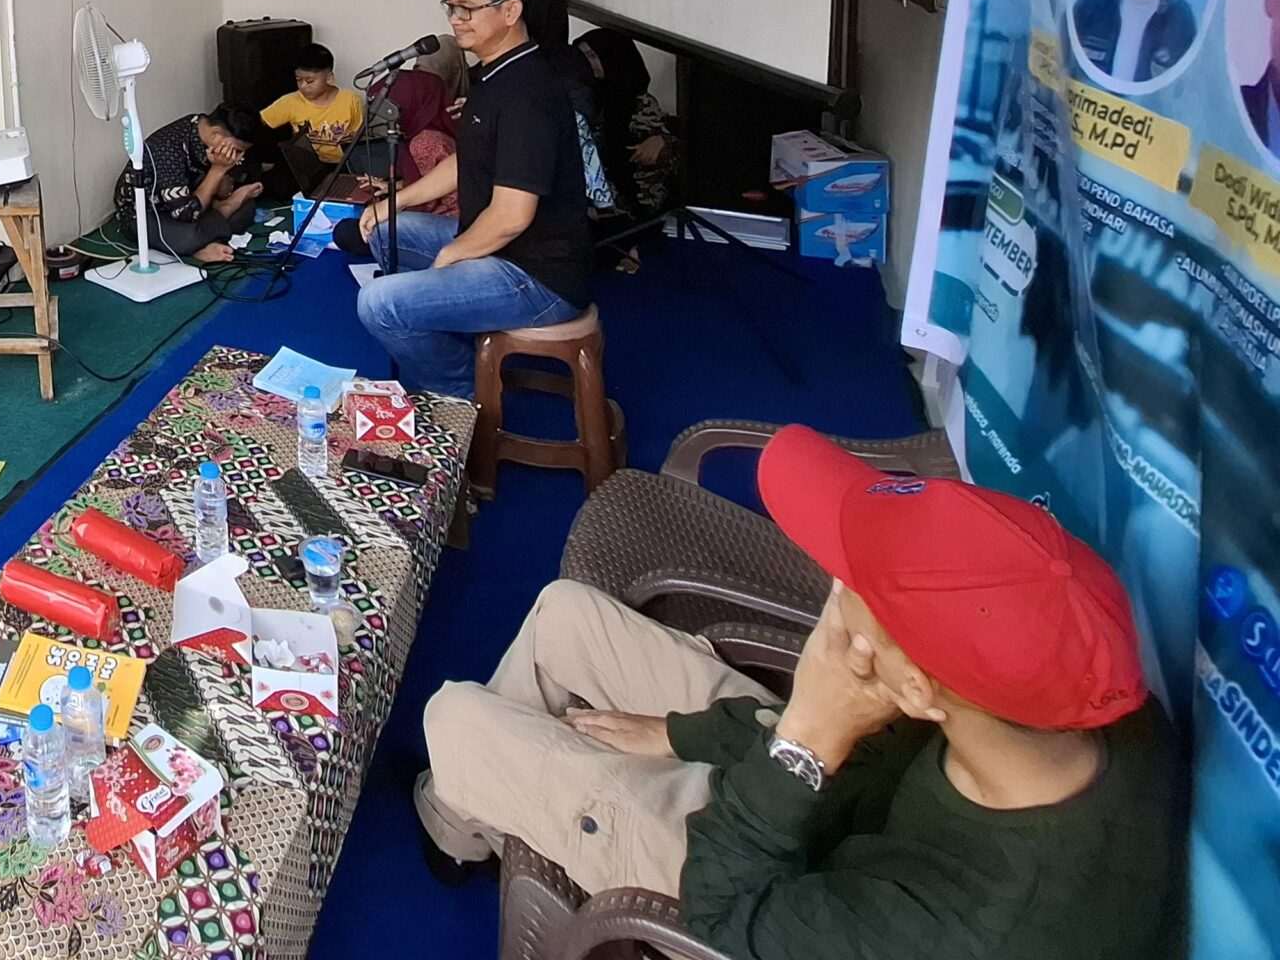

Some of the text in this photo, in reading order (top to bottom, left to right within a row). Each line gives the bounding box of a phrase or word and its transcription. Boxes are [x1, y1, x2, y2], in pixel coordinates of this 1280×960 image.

[1088, 122, 1140, 160] M.Pd
[1122, 198, 1175, 238] BAHASA
[985, 218, 1033, 279] TEMBER
